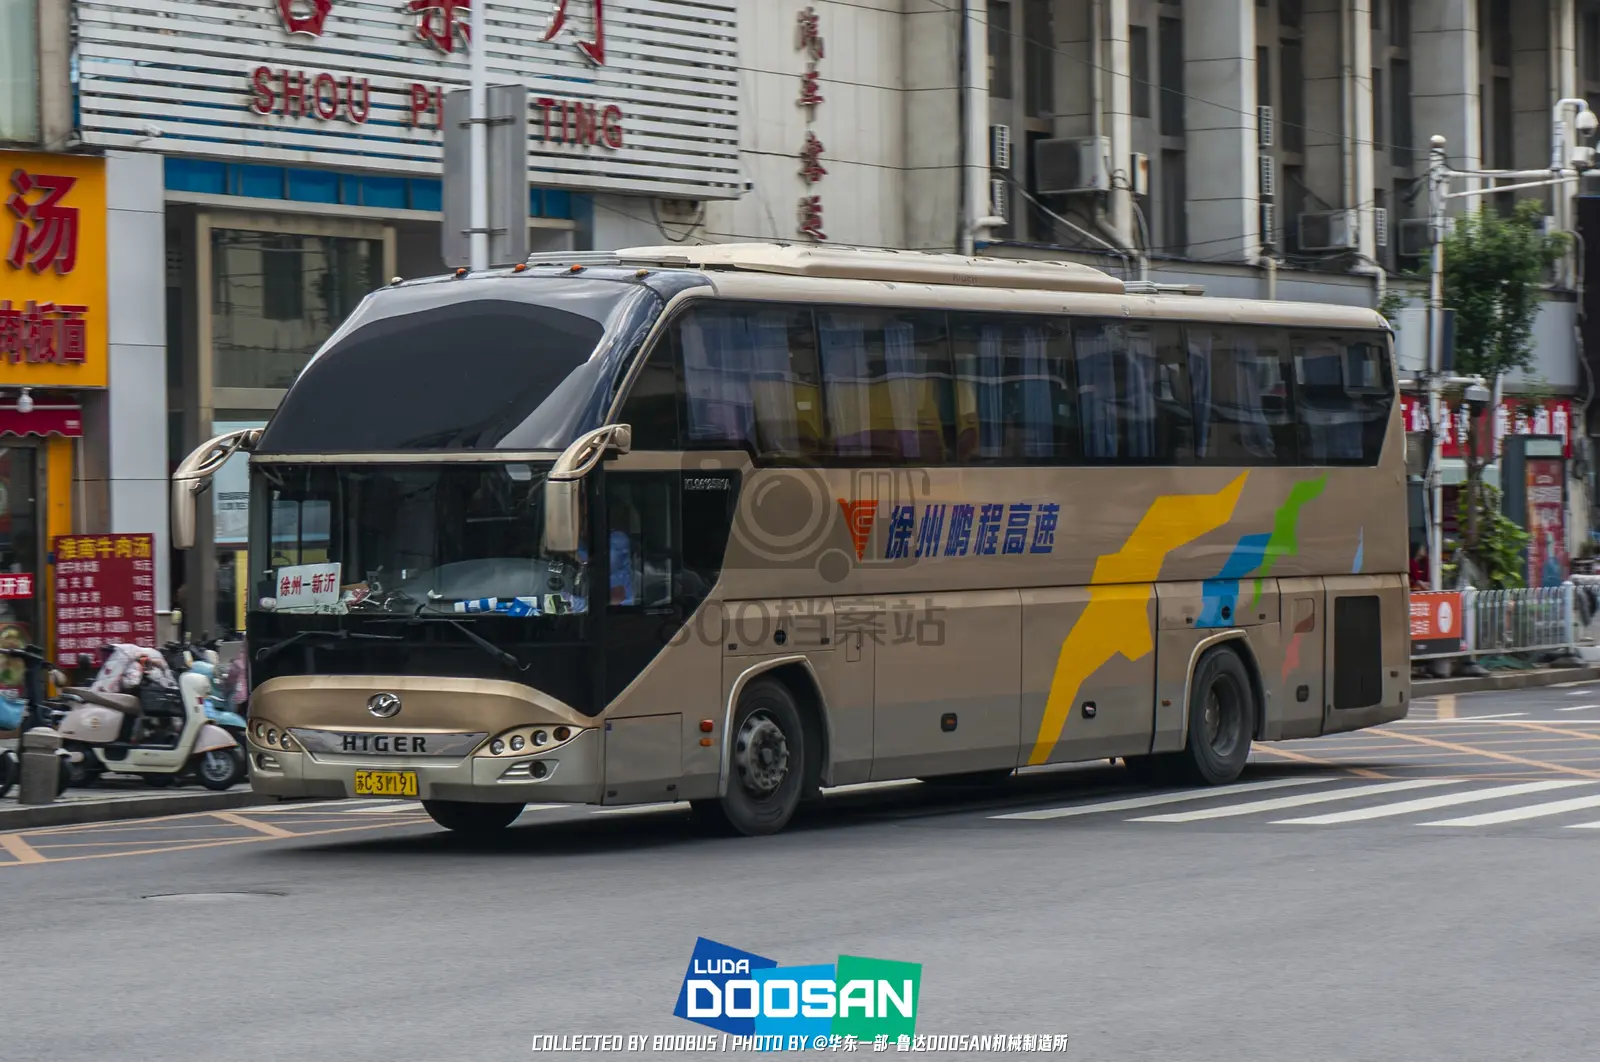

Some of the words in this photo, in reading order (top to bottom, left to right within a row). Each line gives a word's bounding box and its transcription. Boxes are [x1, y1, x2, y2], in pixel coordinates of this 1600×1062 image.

[250, 66, 371, 125] SHOU
[535, 97, 623, 149] TING
[7, 168, 80, 276] 汤
[885, 502, 1060, 559] 徐州鹏程高速
[342, 735, 427, 753] HIGER
